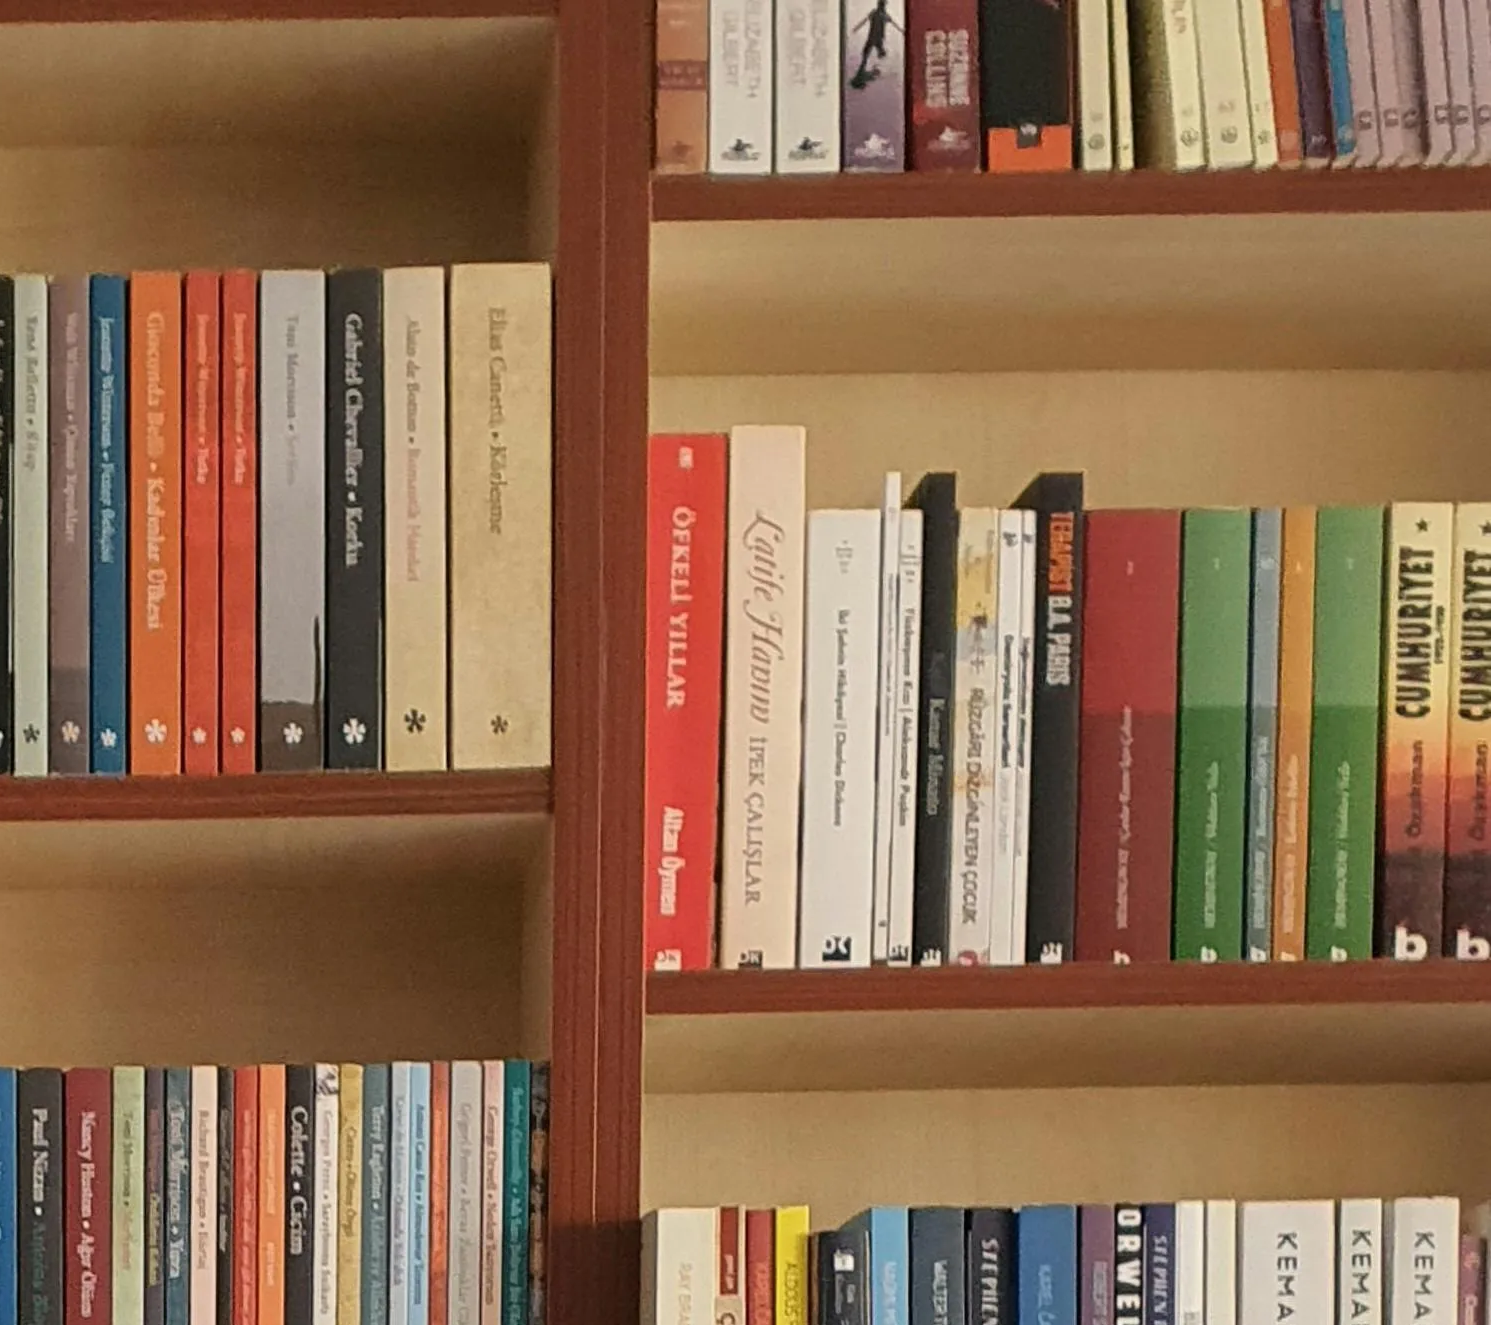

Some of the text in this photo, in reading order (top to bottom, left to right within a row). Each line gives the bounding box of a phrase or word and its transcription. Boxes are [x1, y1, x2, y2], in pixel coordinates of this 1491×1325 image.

[344, 313, 363, 385] Gabriel
[344, 507, 363, 567] Korku
[742, 510, 786, 604] Latife
[1048, 512, 1075, 592] TERAPİST
[666, 507, 696, 709] ÖFKELİ YILLAR
[1395, 546, 1435, 719] CUMHURİYET
[1458, 549, 1491, 722] CUMHURİYET
[663, 806, 685, 851] Altan
[742, 737, 768, 905] İPEK ÇALIŞLAR
[959, 870, 979, 924] ÇOCUK
[32, 1107, 49, 1146] Paul
[288, 1105, 309, 1255] Colette Cicim
